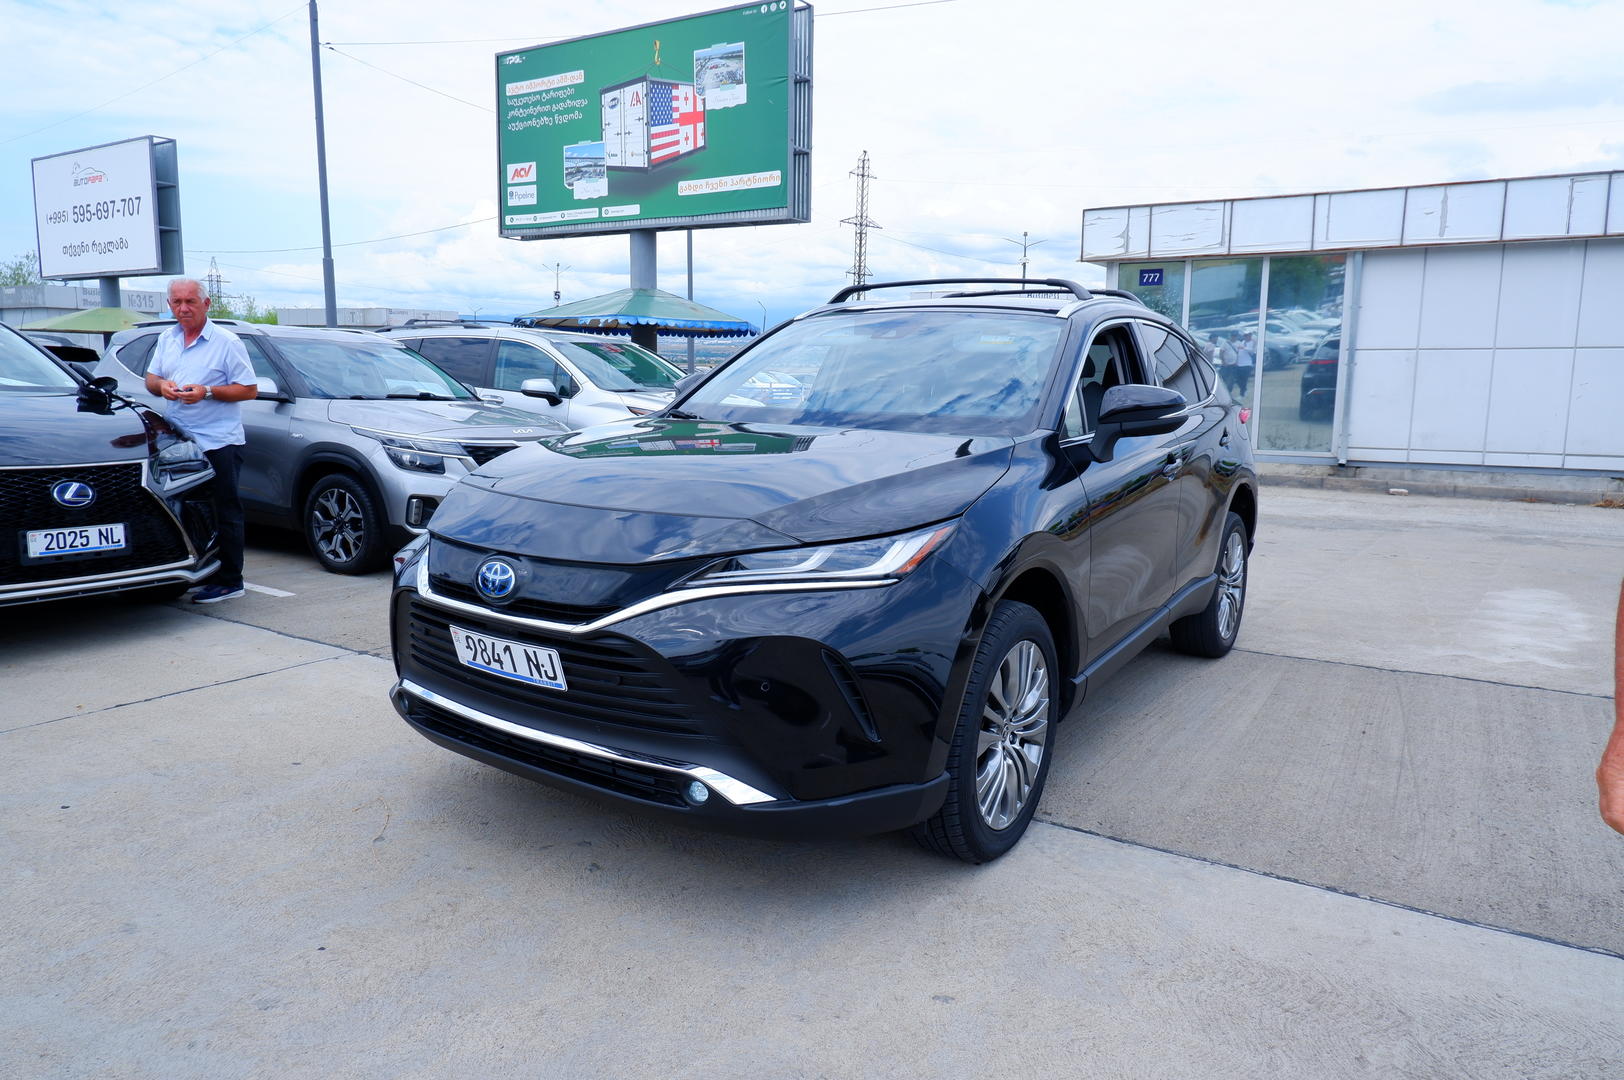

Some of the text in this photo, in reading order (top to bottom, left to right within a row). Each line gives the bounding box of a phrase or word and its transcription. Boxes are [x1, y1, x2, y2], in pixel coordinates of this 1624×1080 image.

[506, 87, 575, 107] საუკეთესო ტარიფები
[506, 98, 588, 120] კონტეინერით გადაზიდვა
[507, 110, 583, 131] აუქციონებზე წვდომა
[511, 164, 533, 181] ACV
[679, 174, 781, 193] გახდი ჩვენი პარტნიორი
[46, 196, 142, 225] (+995) 595-697-707
[62, 237, 129, 258] თქვენი რეკლამა
[1142, 272, 1160, 284] 777
[554, 291, 561, 300] 5
[43, 527, 121, 551] 2025 NL
[465, 634, 558, 682] 9841 NJ
